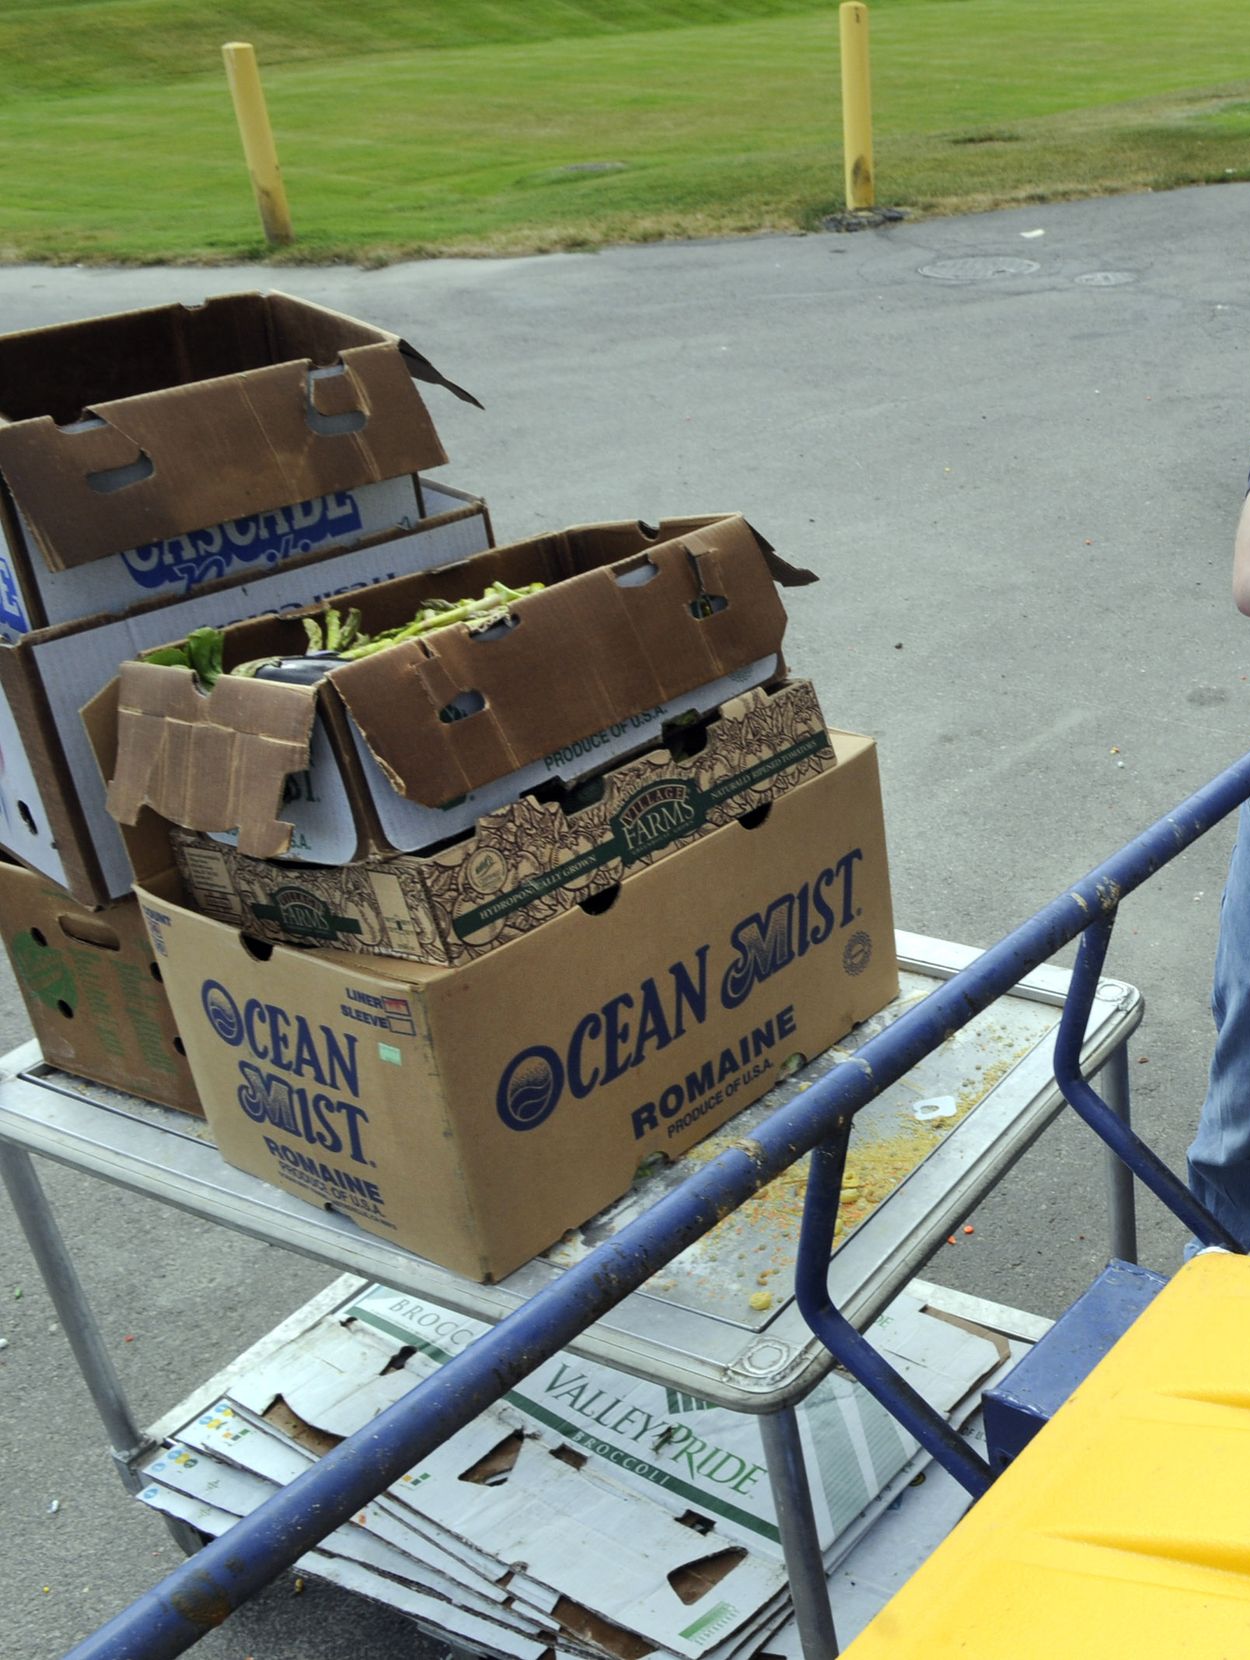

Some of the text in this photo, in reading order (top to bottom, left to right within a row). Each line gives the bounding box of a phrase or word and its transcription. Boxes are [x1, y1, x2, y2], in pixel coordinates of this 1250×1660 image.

[543, 730, 610, 772] PRODUCE
[610, 721, 628, 738] OF
[622, 786, 685, 826] VILLAGE
[623, 800, 695, 850] FARMS
[341, 1004, 389, 1028] SLEEVE
[345, 987, 384, 1009] LINER
[496, 848, 864, 1132] OCEAN MIST
[202, 979, 360, 1098] OCEAN
[631, 1005, 797, 1140] ROMAINE
[237, 1060, 370, 1166] MIST
[667, 1089, 724, 1138] PRODUCE
[725, 1078, 741, 1097] OF
[263, 1135, 385, 1205] ROMAINE
[388, 1298, 475, 1346] BROCC
[571, 1430, 671, 1486] BROCCOLI
